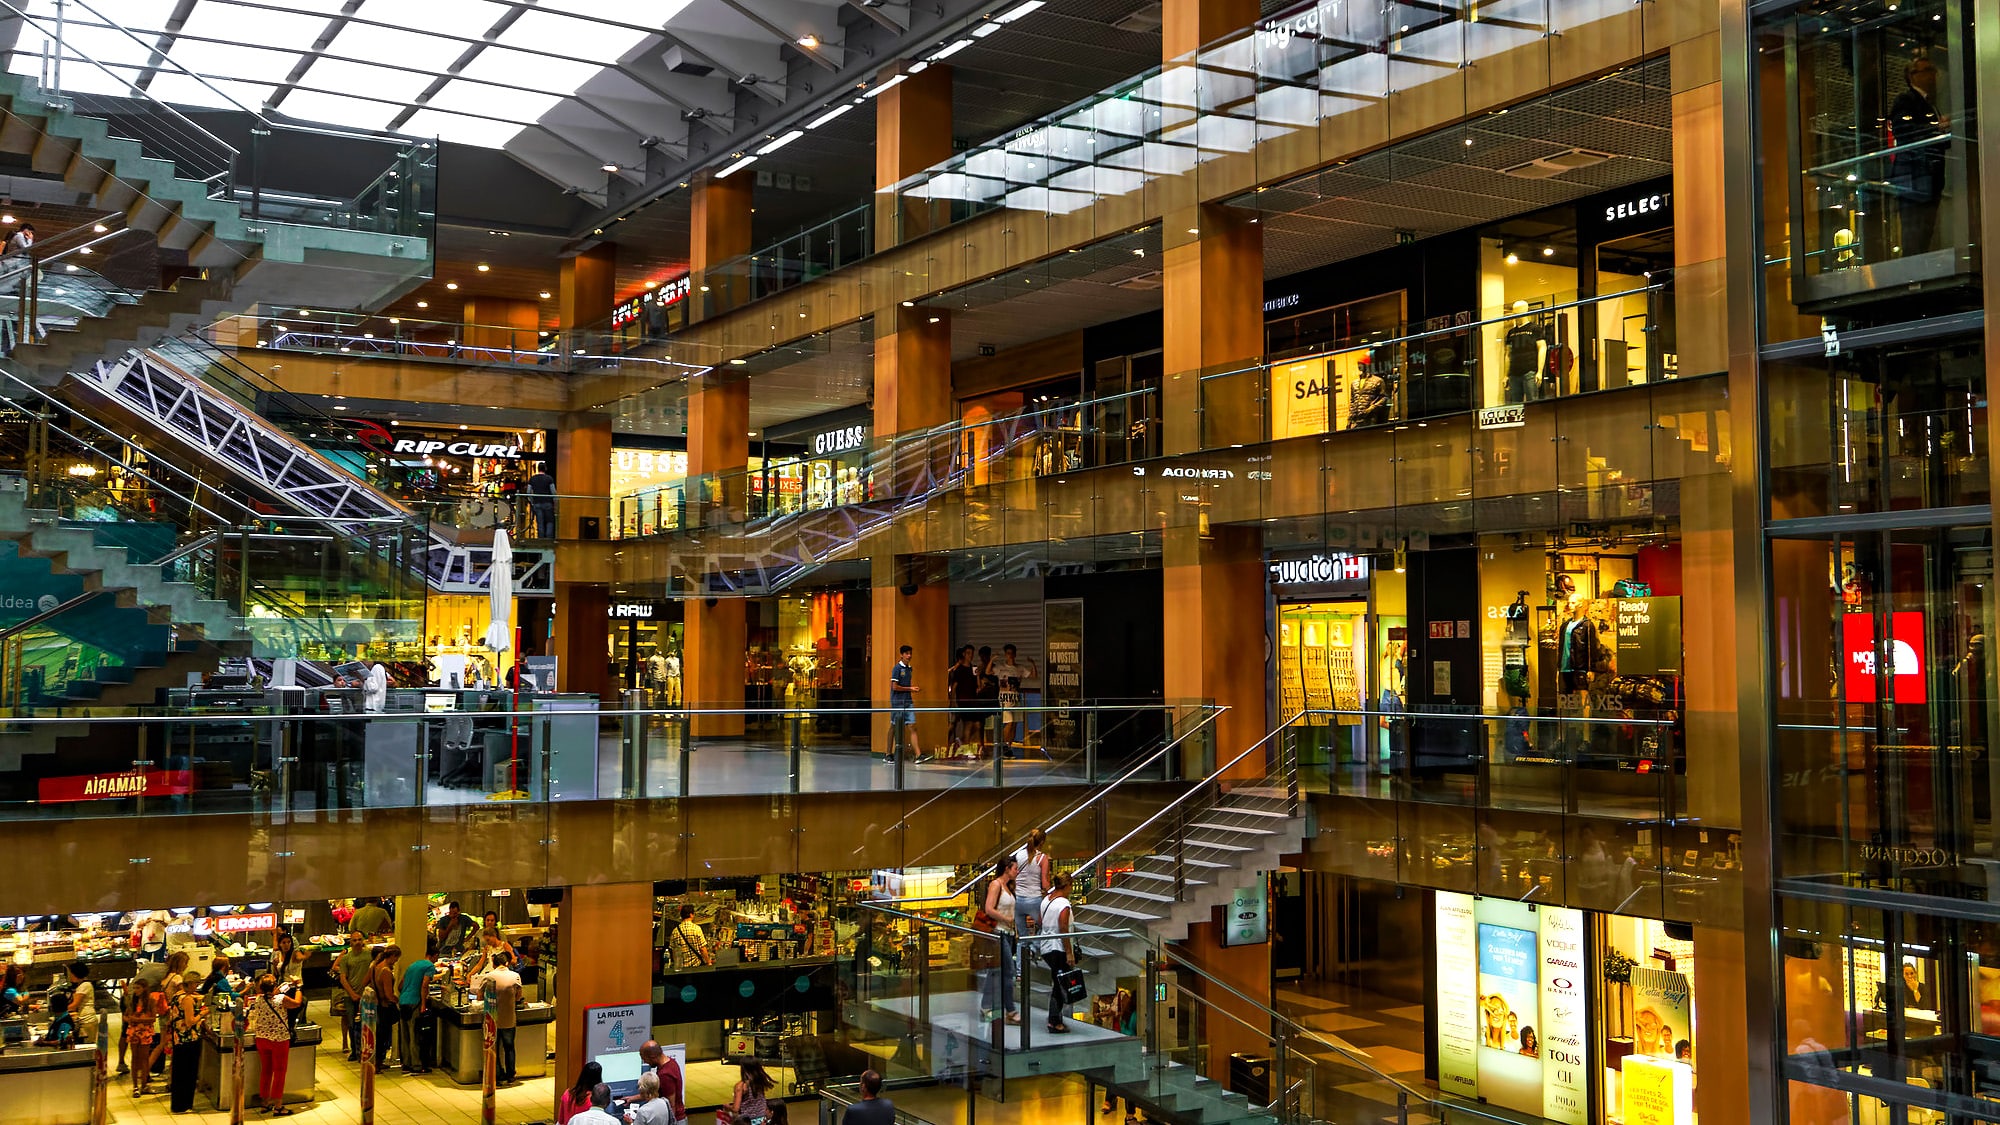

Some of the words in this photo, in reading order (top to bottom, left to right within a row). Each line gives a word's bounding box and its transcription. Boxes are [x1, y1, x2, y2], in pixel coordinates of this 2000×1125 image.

[1606, 192, 1671, 222] SELECT
[1262, 294, 1299, 312] rmance
[1295, 374, 1343, 399] SALE
[815, 425, 866, 455] GUESS
[393, 439, 446, 454] RIP
[447, 441, 522, 459] CURL
[612, 451, 688, 473] UESS
[1269, 552, 1345, 584] swatch
[616, 604, 653, 618] RAW
[1619, 600, 1650, 614] Ready
[1619, 613, 1633, 625] for
[1634, 612, 1651, 625] the
[1619, 625, 1639, 638] wild
[1049, 673, 1079, 686] AVENTURA
[218, 915, 273, 931] EROSKI
[1546, 957, 1578, 968] CARRERA
[607, 1009, 634, 1018] RULETA
[608, 1019, 624, 1047] 4
[1548, 1048, 1581, 1066] TOUS
[1555, 1095, 1576, 1108] POLO
